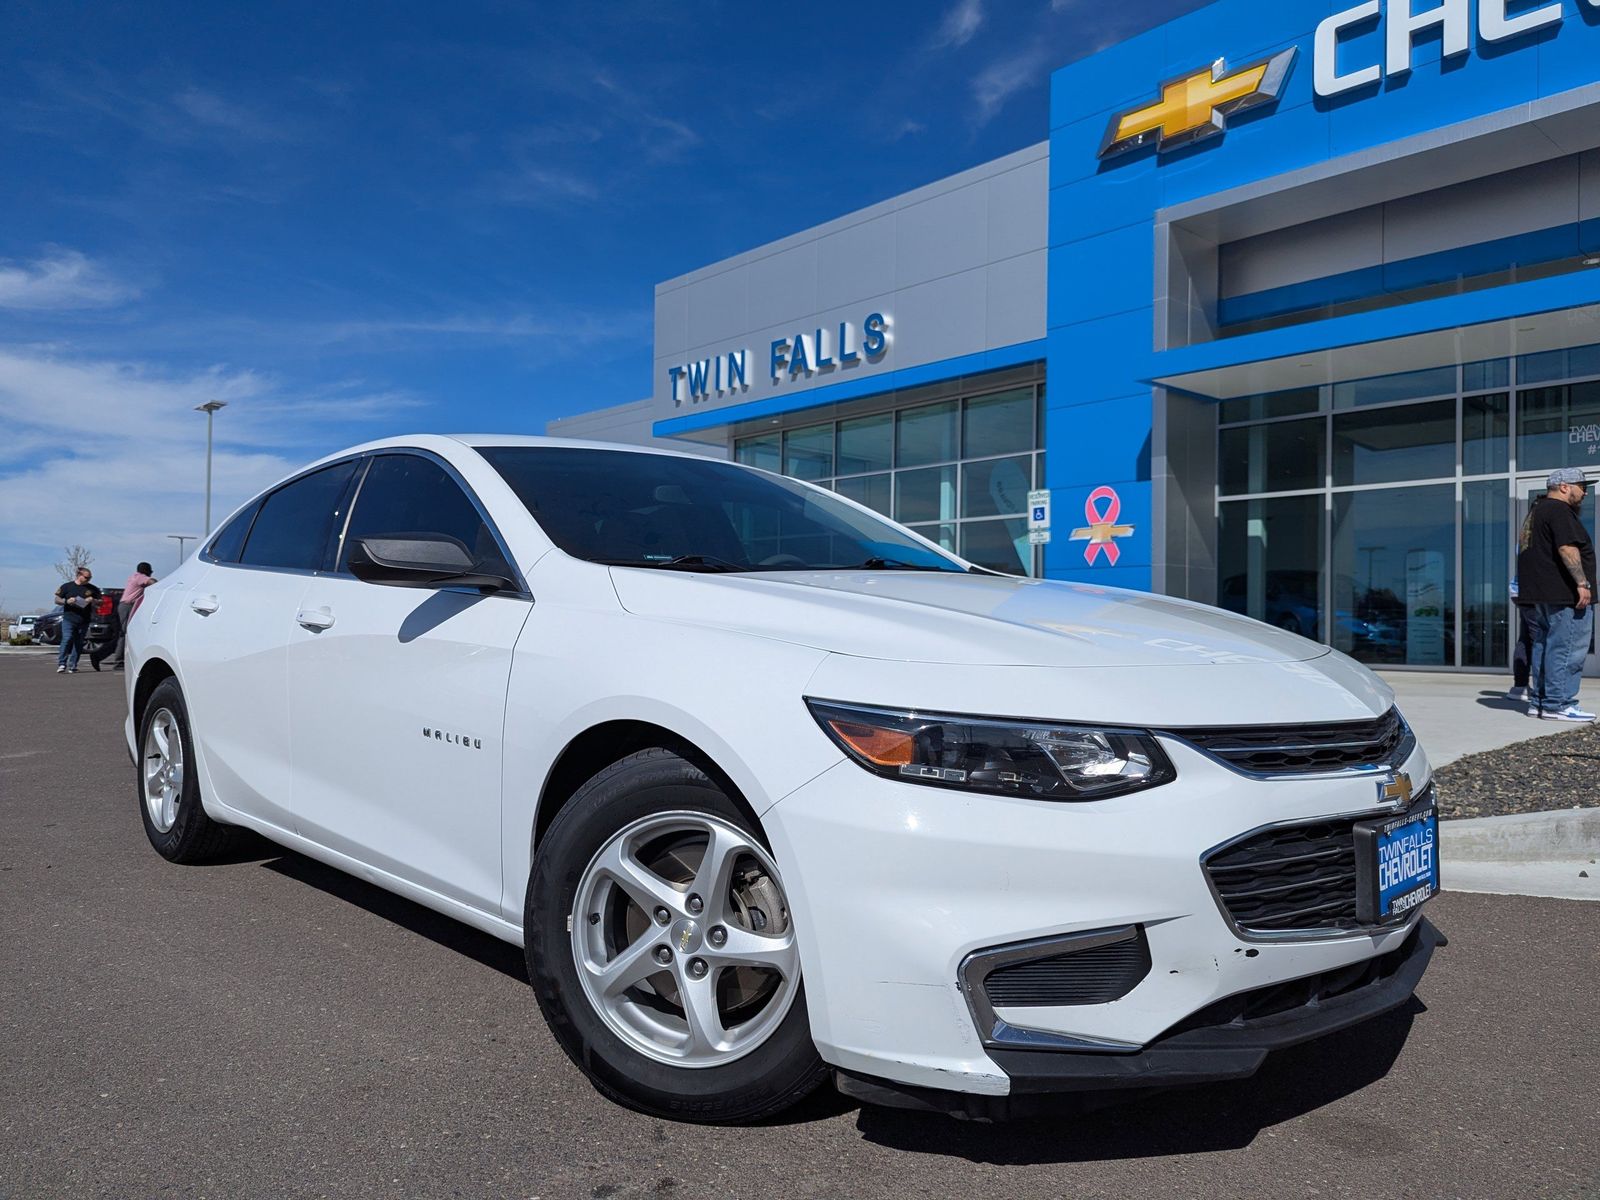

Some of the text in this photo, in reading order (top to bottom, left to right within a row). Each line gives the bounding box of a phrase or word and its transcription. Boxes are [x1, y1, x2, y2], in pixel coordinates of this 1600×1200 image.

[668, 312, 889, 402] TWIN FALLS
[422, 727, 482, 750] MALIBU
[1379, 828, 1433, 864] TWINFALLS
[1379, 843, 1433, 892] CHEVROLET
[1404, 883, 1432, 910] CHEVROLET
